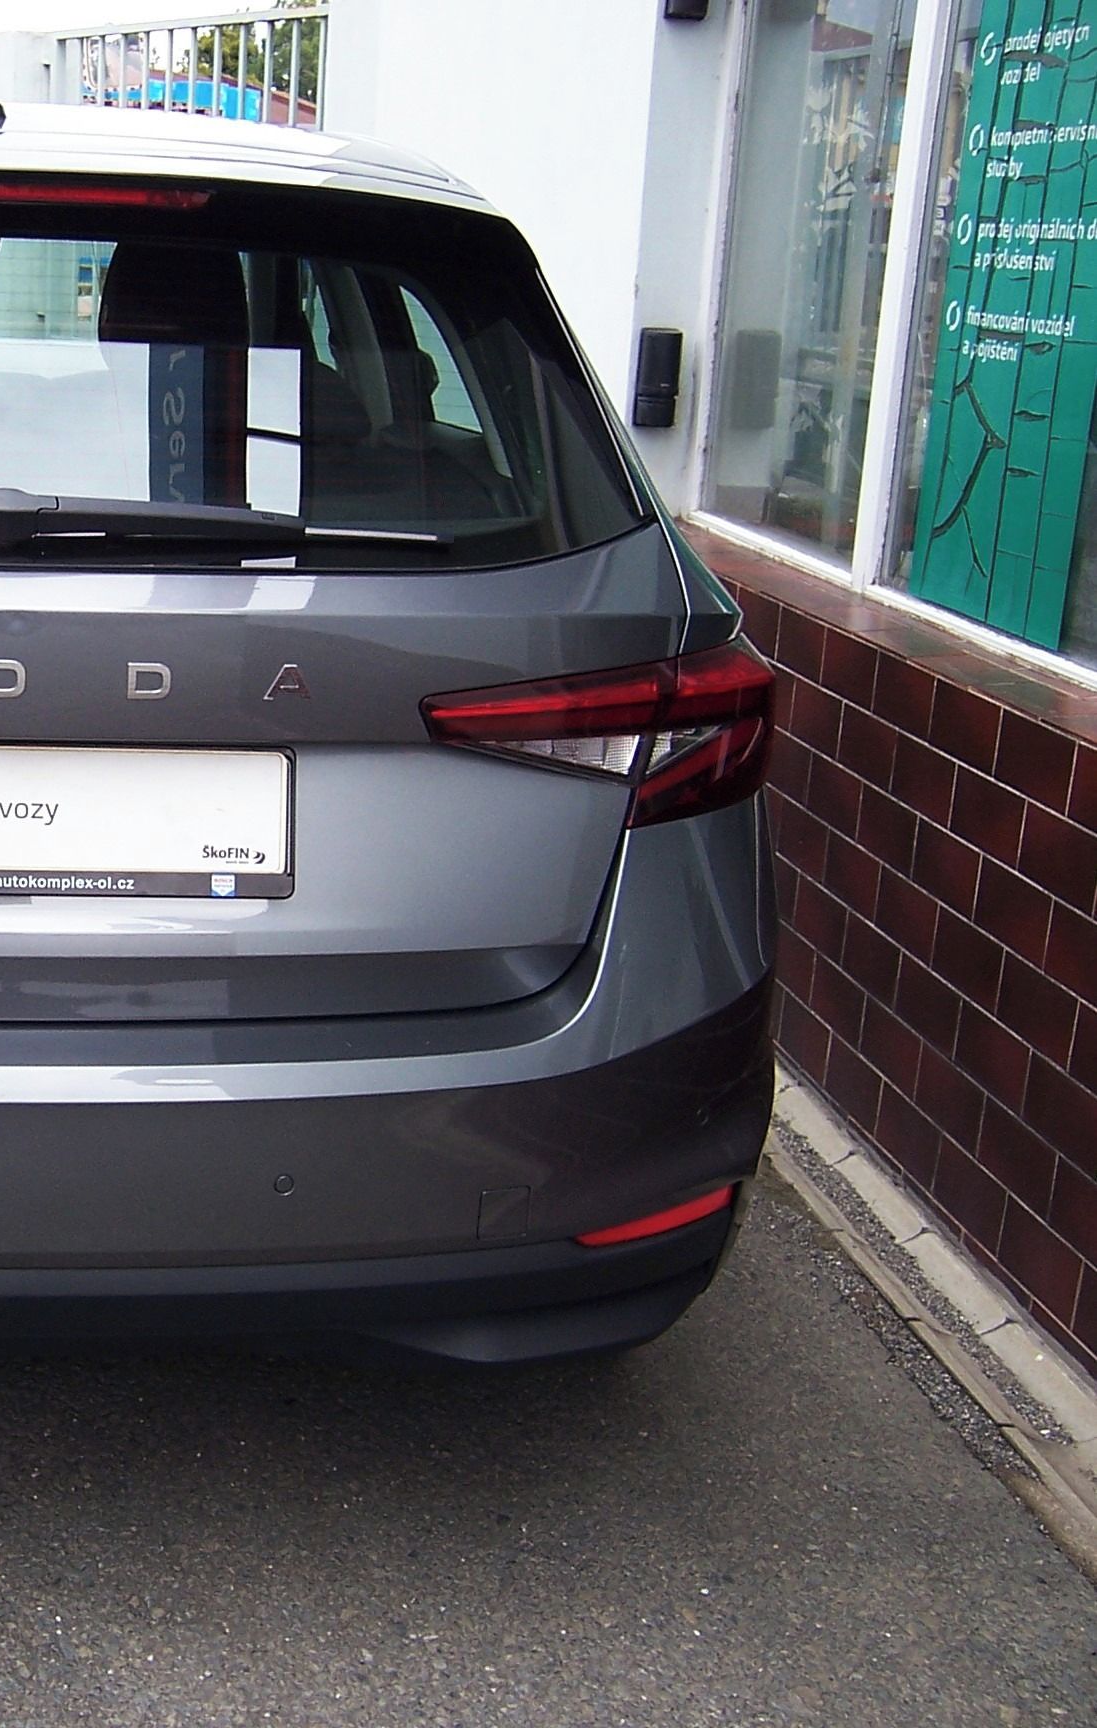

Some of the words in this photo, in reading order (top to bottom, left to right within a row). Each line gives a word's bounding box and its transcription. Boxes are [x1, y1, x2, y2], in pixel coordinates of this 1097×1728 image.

[1004, 25, 1042, 54] prodej
[1000, 62, 1042, 85] vozidel
[991, 122, 1051, 151] kompletní
[985, 156, 1024, 181] služby
[977, 218, 1014, 244] prodej
[1014, 217, 1085, 245] originálních
[974, 252, 982, 267] a
[967, 305, 1031, 331] financování
[1031, 314, 1076, 337] vozidel
[962, 339, 970, 355] a
[969, 339, 1018, 363] pojištění
[202, 845, 249, 859] ŠkoFIN
